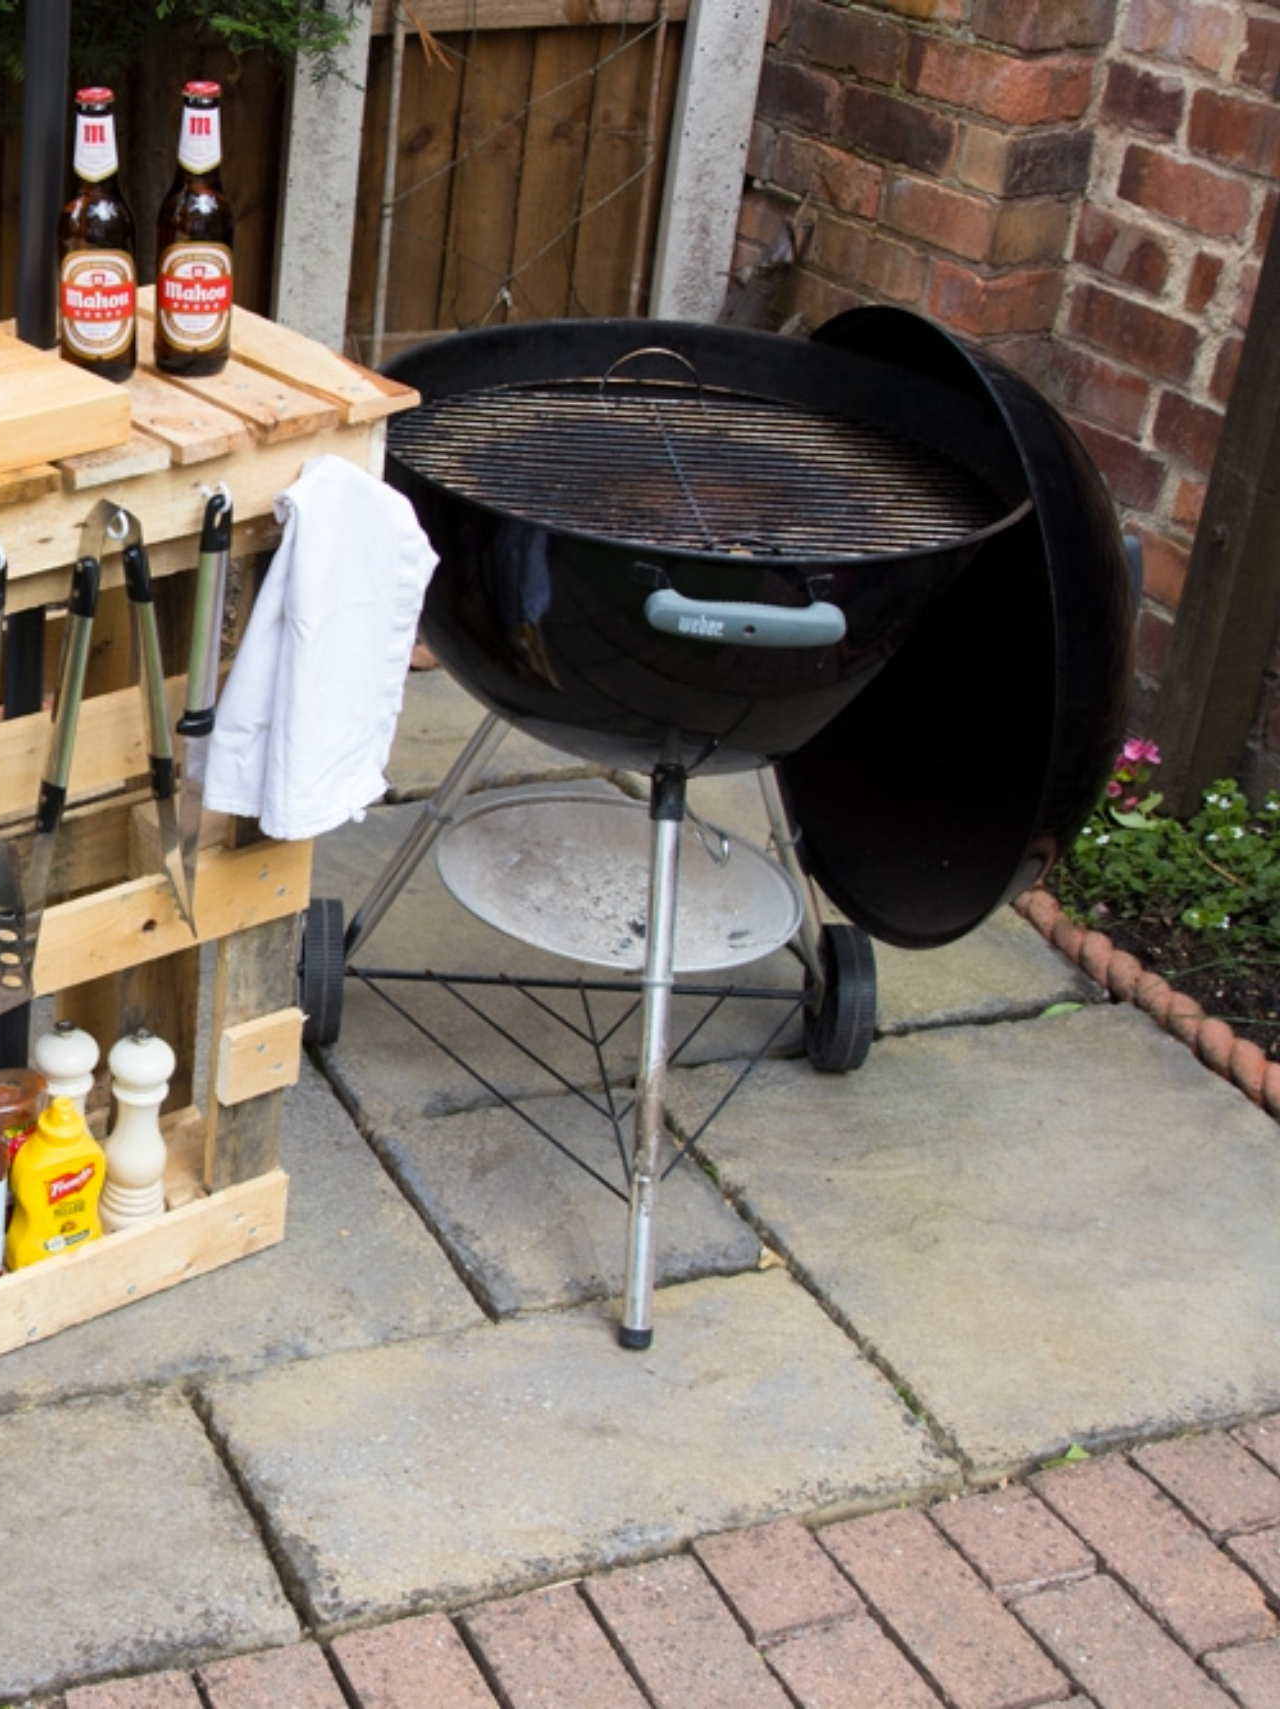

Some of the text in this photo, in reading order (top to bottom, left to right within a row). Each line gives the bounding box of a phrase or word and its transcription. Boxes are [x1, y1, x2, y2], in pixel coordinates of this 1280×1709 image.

[65, 288, 129, 309] Mahou
[164, 280, 227, 302] Mahou
[677, 614, 726, 637] weber
